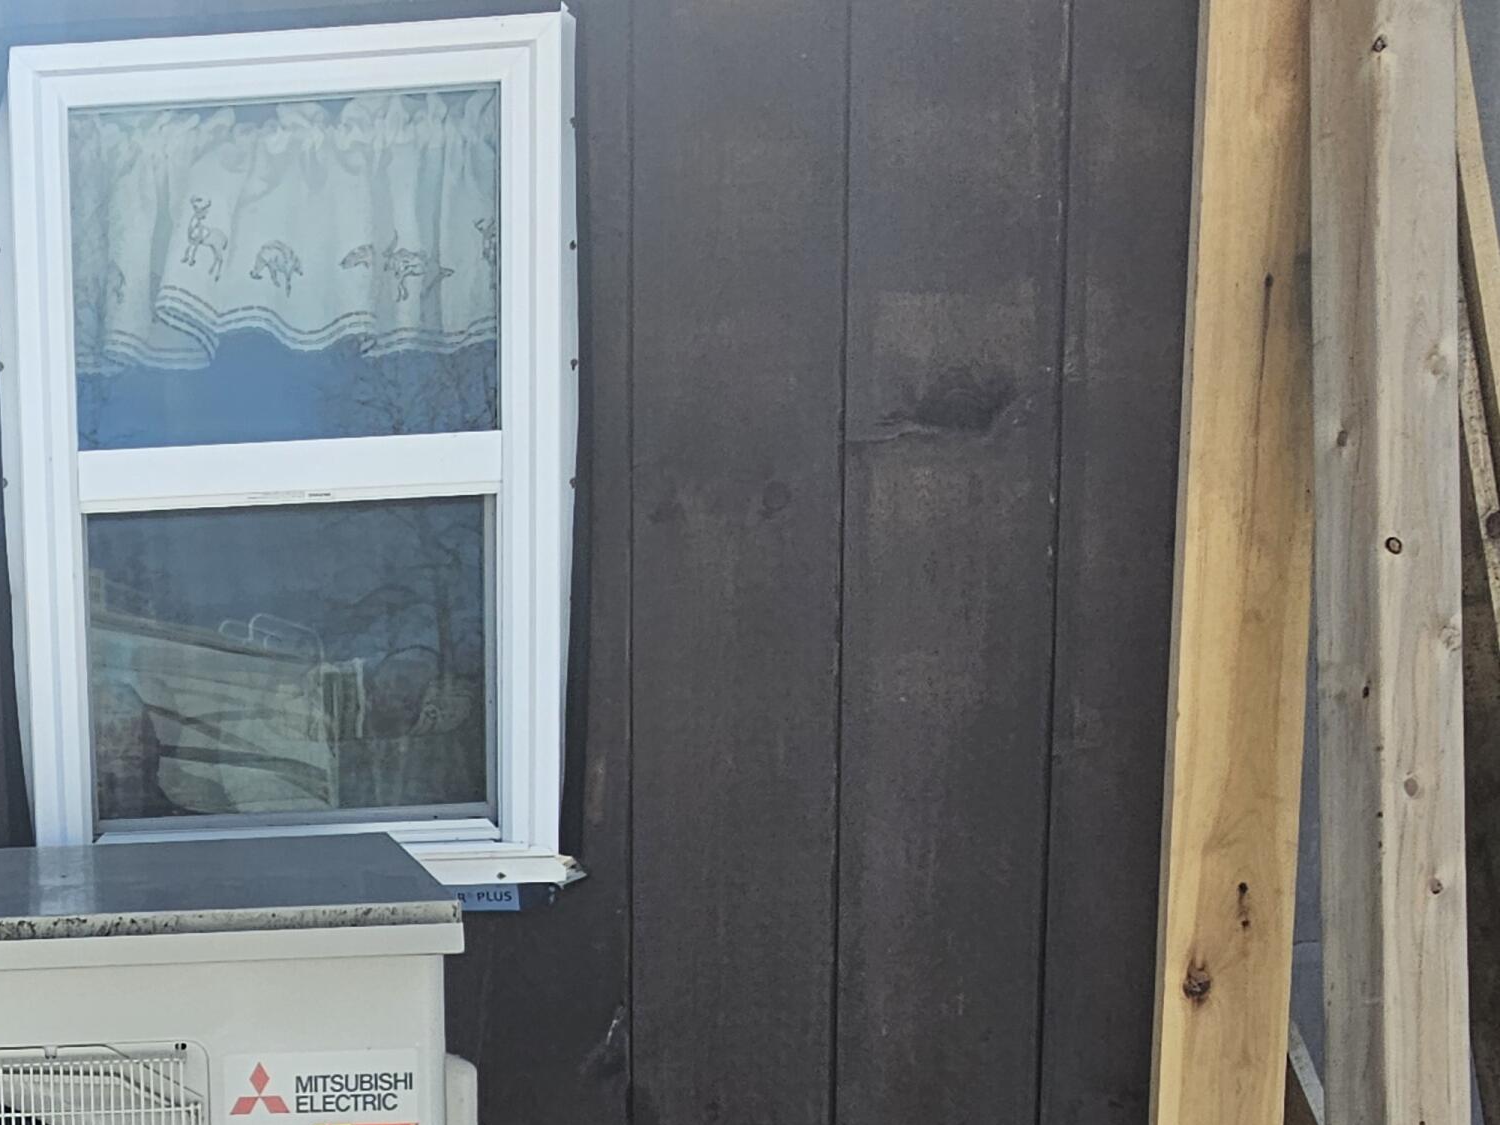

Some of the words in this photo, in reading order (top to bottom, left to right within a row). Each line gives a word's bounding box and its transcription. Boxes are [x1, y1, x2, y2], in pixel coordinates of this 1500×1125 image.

[476, 890, 513, 903] PLUS
[295, 1072, 413, 1094] MITSUBISHI
[295, 1093, 399, 1114] ELECTRIC
